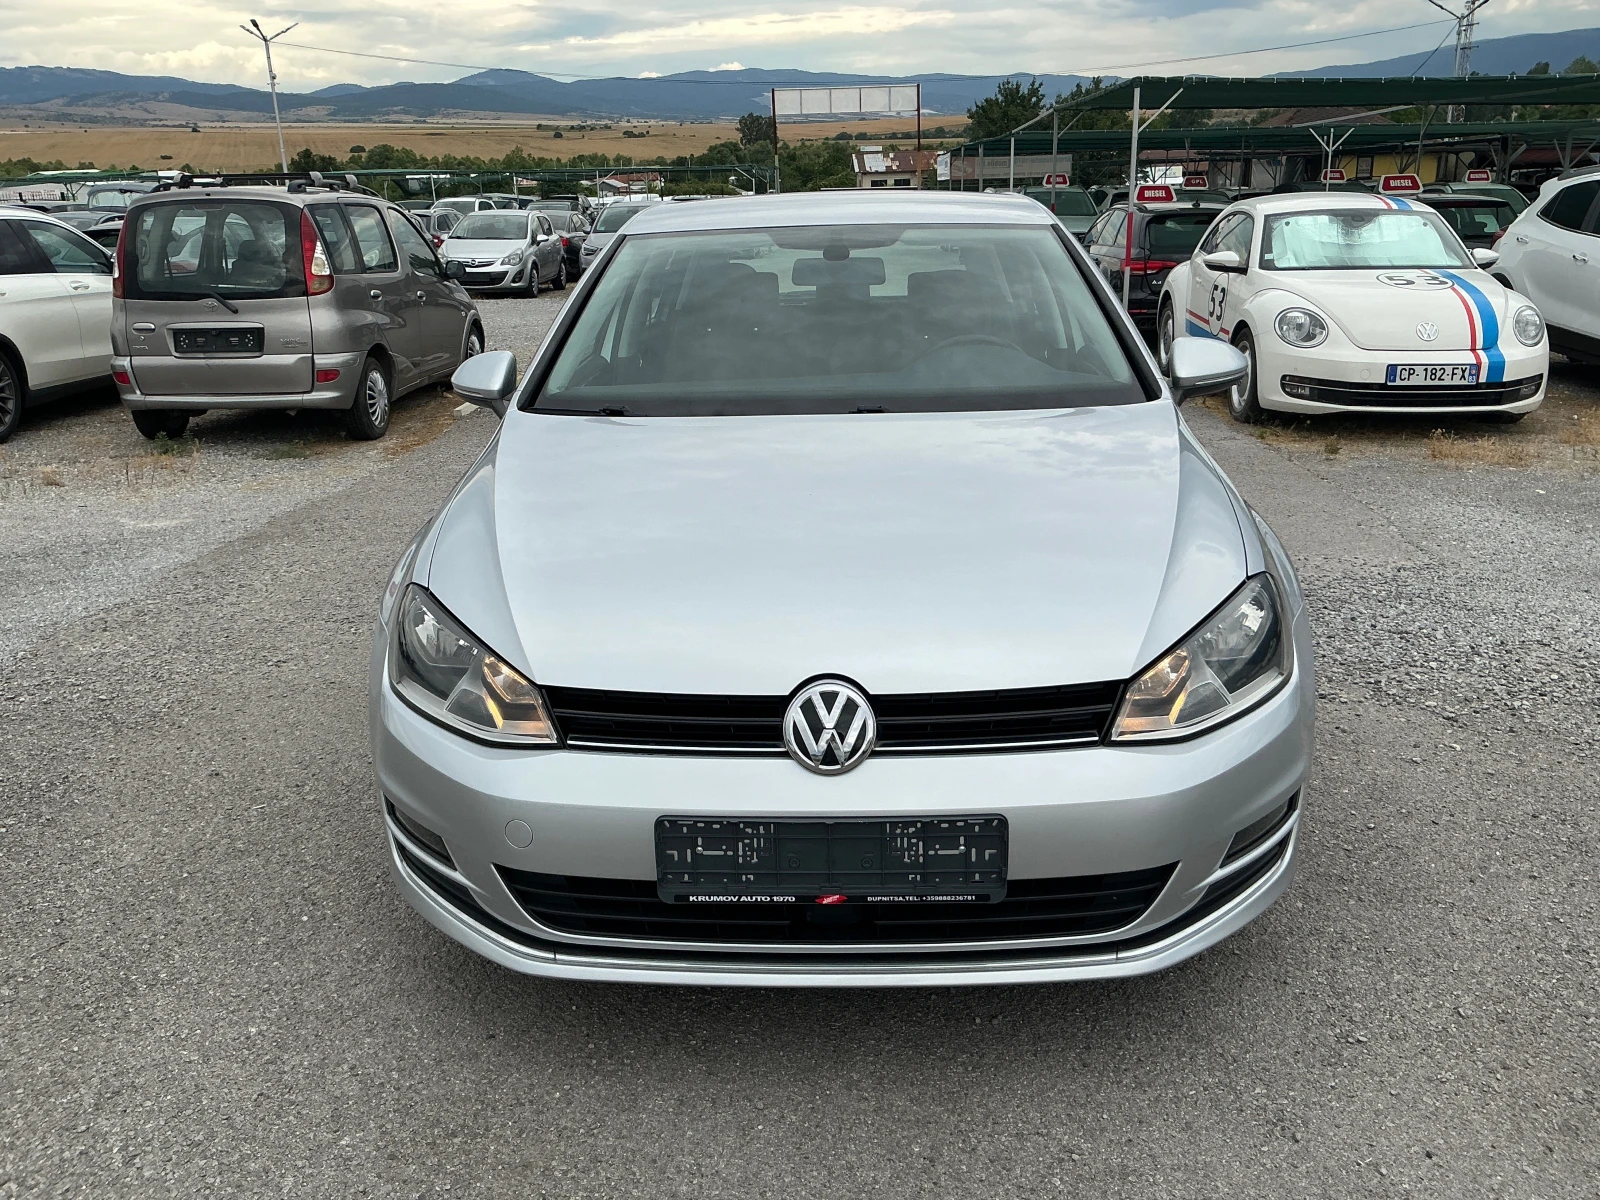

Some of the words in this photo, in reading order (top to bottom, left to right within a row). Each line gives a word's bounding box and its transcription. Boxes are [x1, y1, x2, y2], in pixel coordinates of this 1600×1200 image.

[1389, 179, 1413, 187] DIESEL
[1144, 190, 1166, 198] DIESEL
[1384, 275, 1449, 286] 53
[1209, 284, 1226, 322] 53
[1399, 367, 1468, 381] CP-182-FX
[1468, 375, 1476, 383] 83
[784, 681, 875, 773] VW
